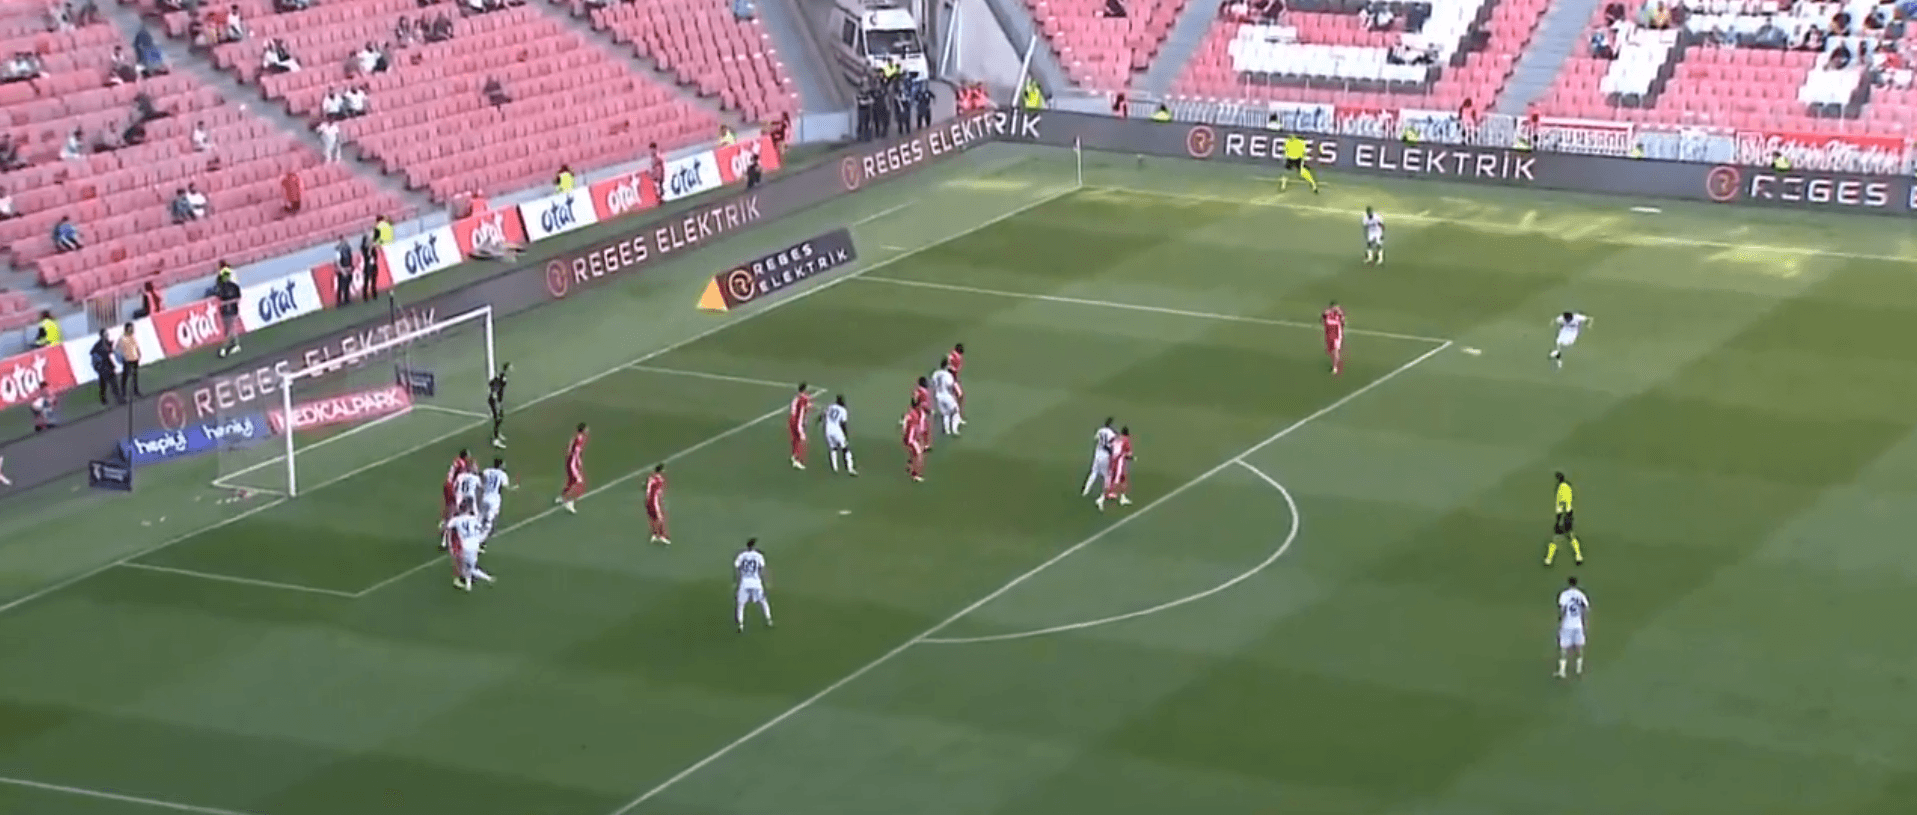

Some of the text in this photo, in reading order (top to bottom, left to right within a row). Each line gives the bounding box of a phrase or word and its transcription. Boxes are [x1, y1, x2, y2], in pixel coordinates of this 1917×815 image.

[863, 139, 923, 179] REGES
[541, 195, 576, 233] otat
[608, 173, 642, 214] otat
[404, 233, 440, 275] otat
[572, 236, 648, 284] REGES
[259, 279, 298, 322] otat
[177, 301, 221, 347] otat
